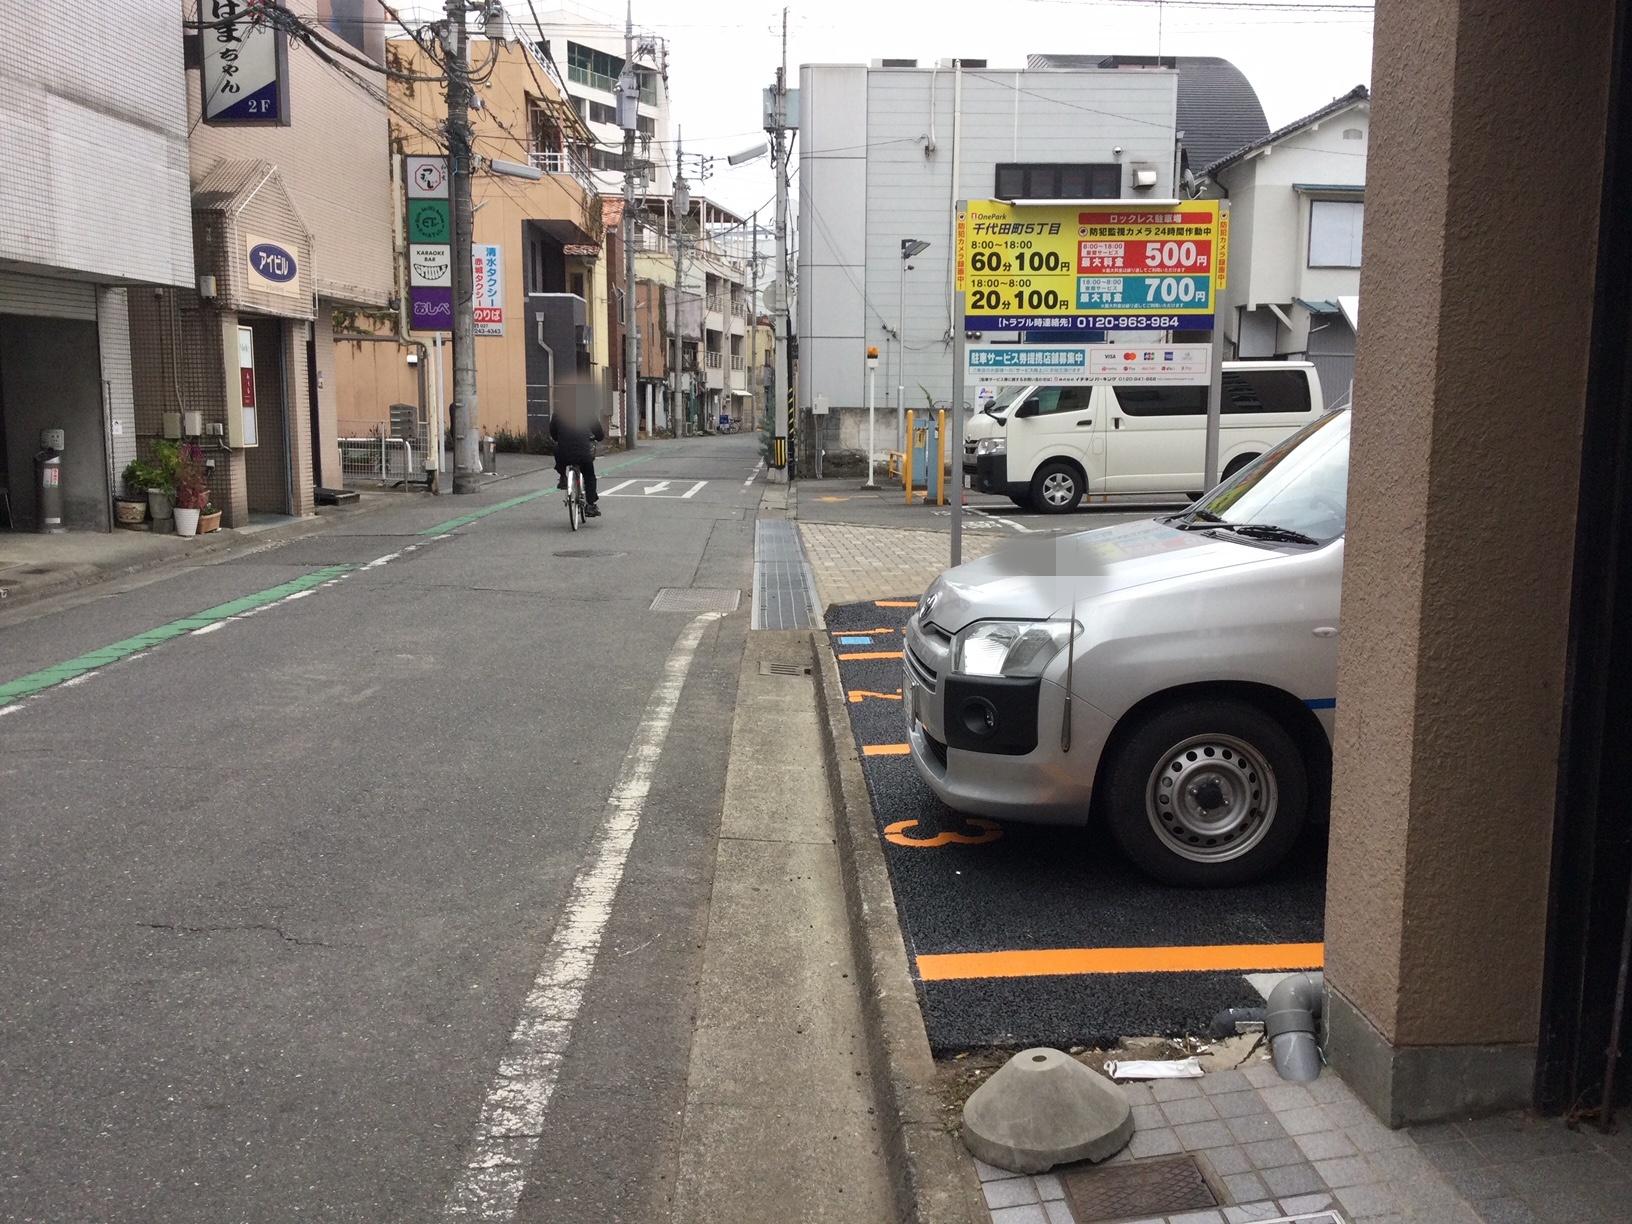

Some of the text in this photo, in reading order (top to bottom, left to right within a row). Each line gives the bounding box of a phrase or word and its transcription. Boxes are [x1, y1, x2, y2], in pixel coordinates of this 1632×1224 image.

[248, 99, 271, 113] 2F
[1109, 214, 1182, 224] ロックレス駐車場
[973, 222, 1062, 236] 千代田町5丁目
[1090, 227, 1152, 237] 防犯監視カメラ
[1145, 241, 1208, 268] 500円
[259, 251, 289, 276] アイビル
[1081, 257, 1124, 268] 最大料金
[474, 258, 484, 307] 赤城タクシー
[486, 247, 497, 307] 清水タクシー
[1144, 277, 1206, 302] 700円
[1080, 292, 1123, 303] 最大料金
[414, 301, 451, 316] あしべ
[474, 309, 501, 321] のりば
[1076, 316, 1180, 328] 0120-963-984
